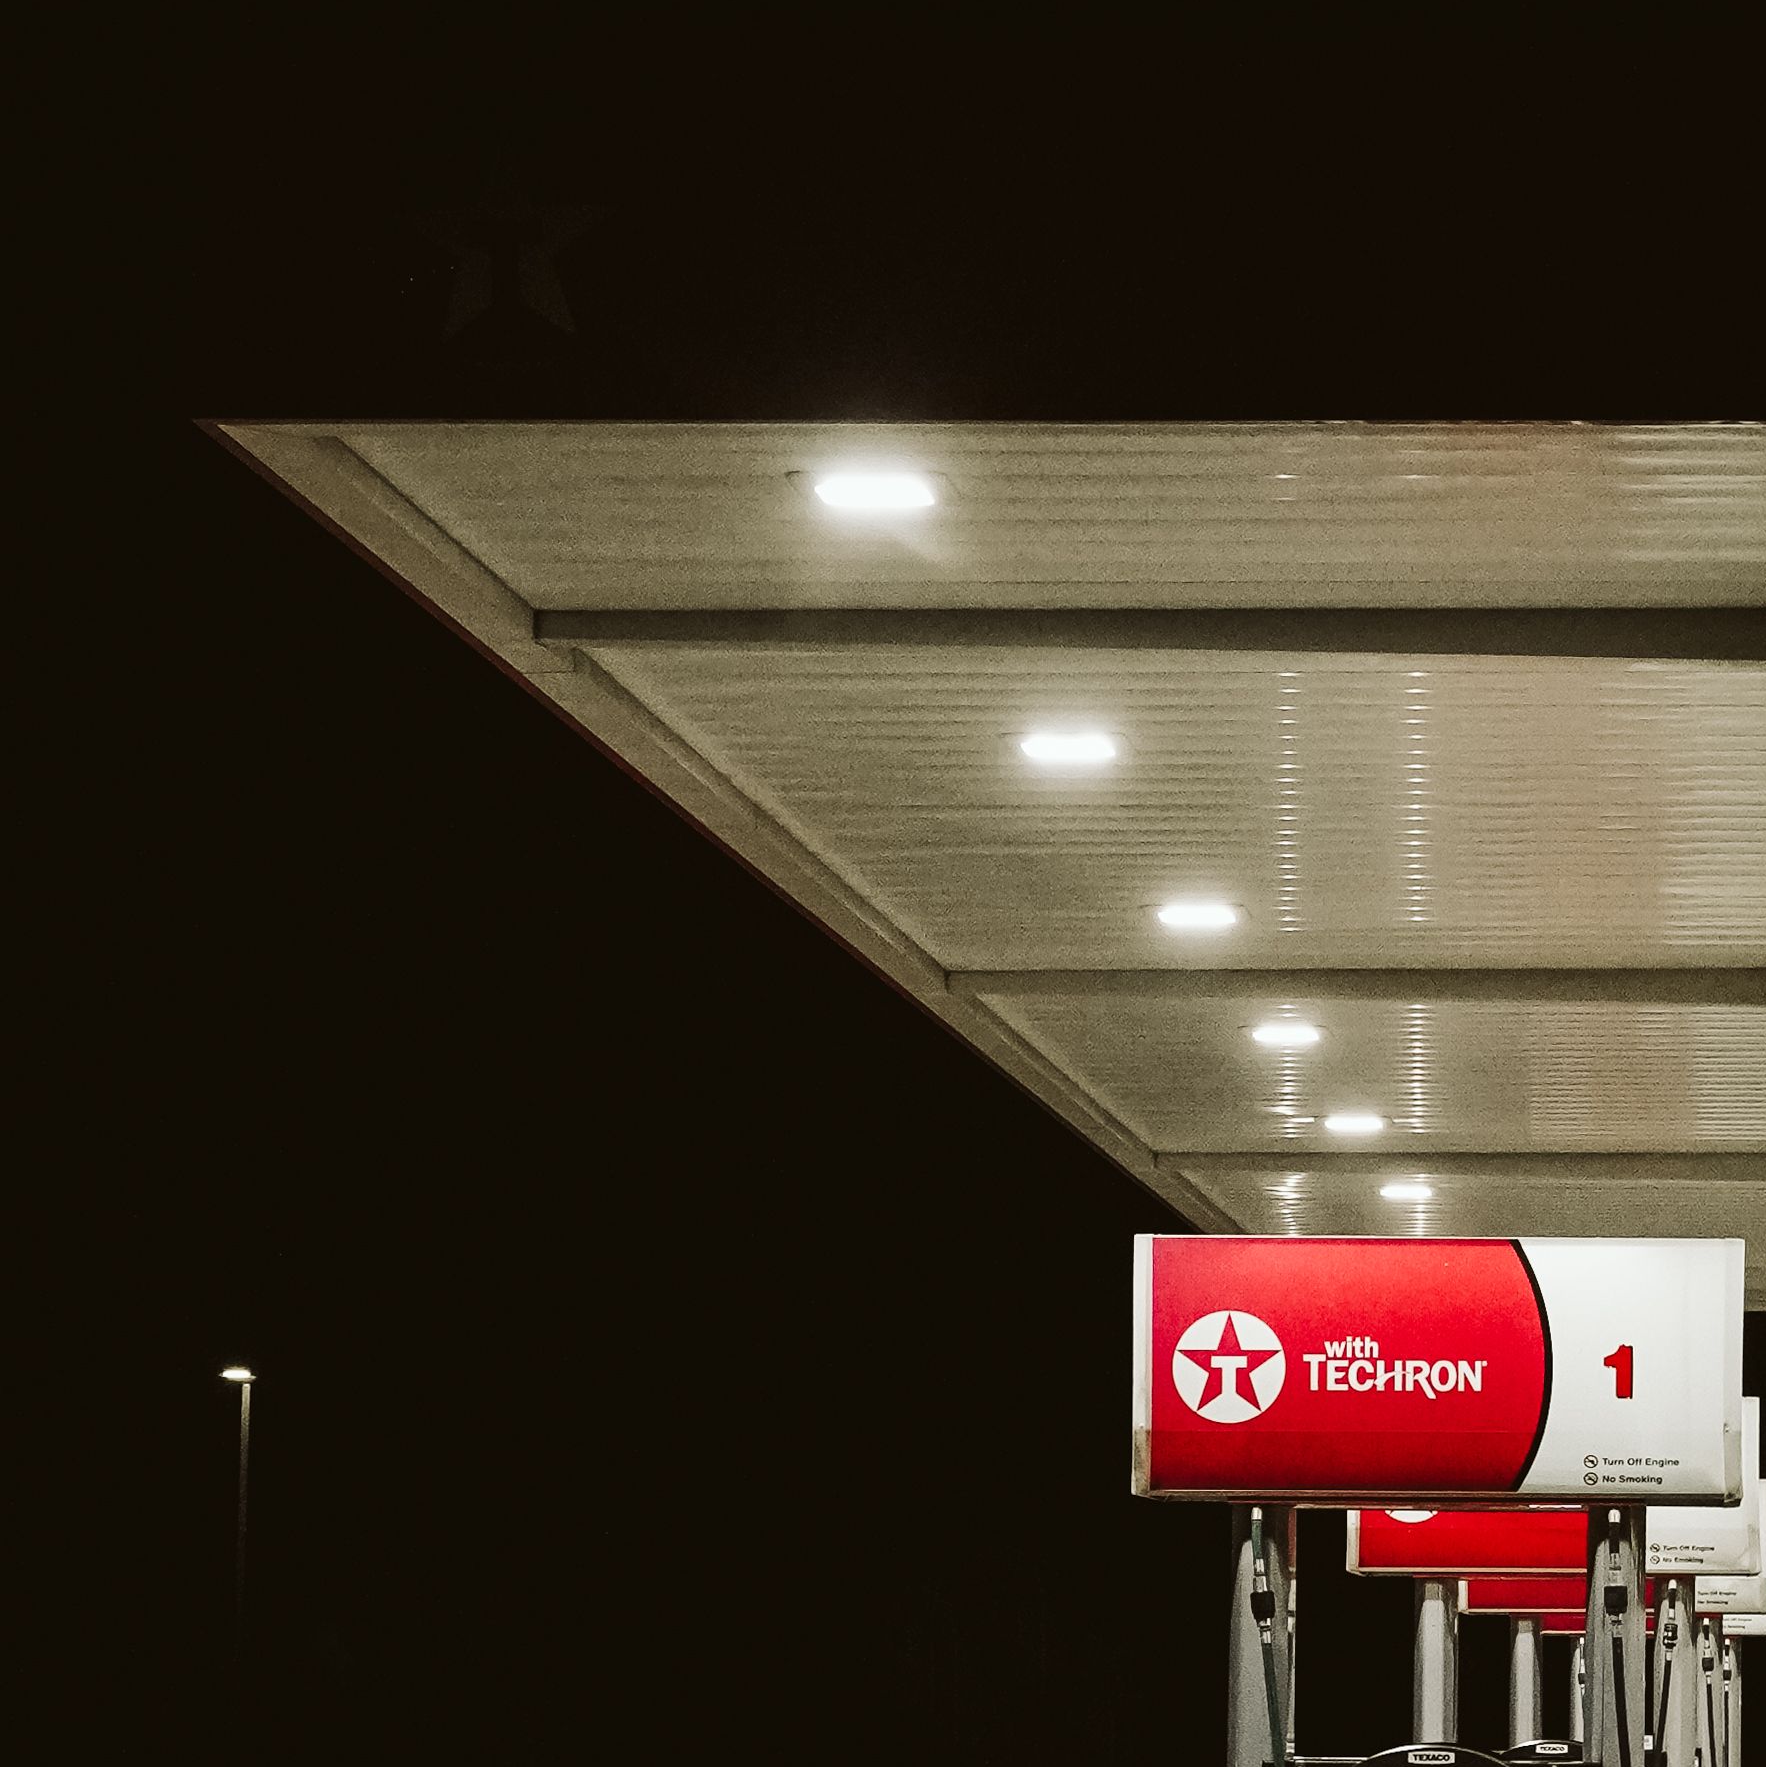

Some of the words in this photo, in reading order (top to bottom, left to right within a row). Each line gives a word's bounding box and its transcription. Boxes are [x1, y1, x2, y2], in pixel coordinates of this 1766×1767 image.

[1324, 1336, 1378, 1359] with
[1303, 1353, 1482, 1400] TECHRON
[1603, 1344, 1633, 1399] 1
[1602, 1457, 1625, 1467] Turn
[1627, 1457, 1643, 1467] Off
[1645, 1457, 1680, 1469] Engine
[1602, 1475, 1616, 1484] No
[1618, 1474, 1663, 1486] Smoking
[1412, 1754, 1451, 1762] TEXACO
